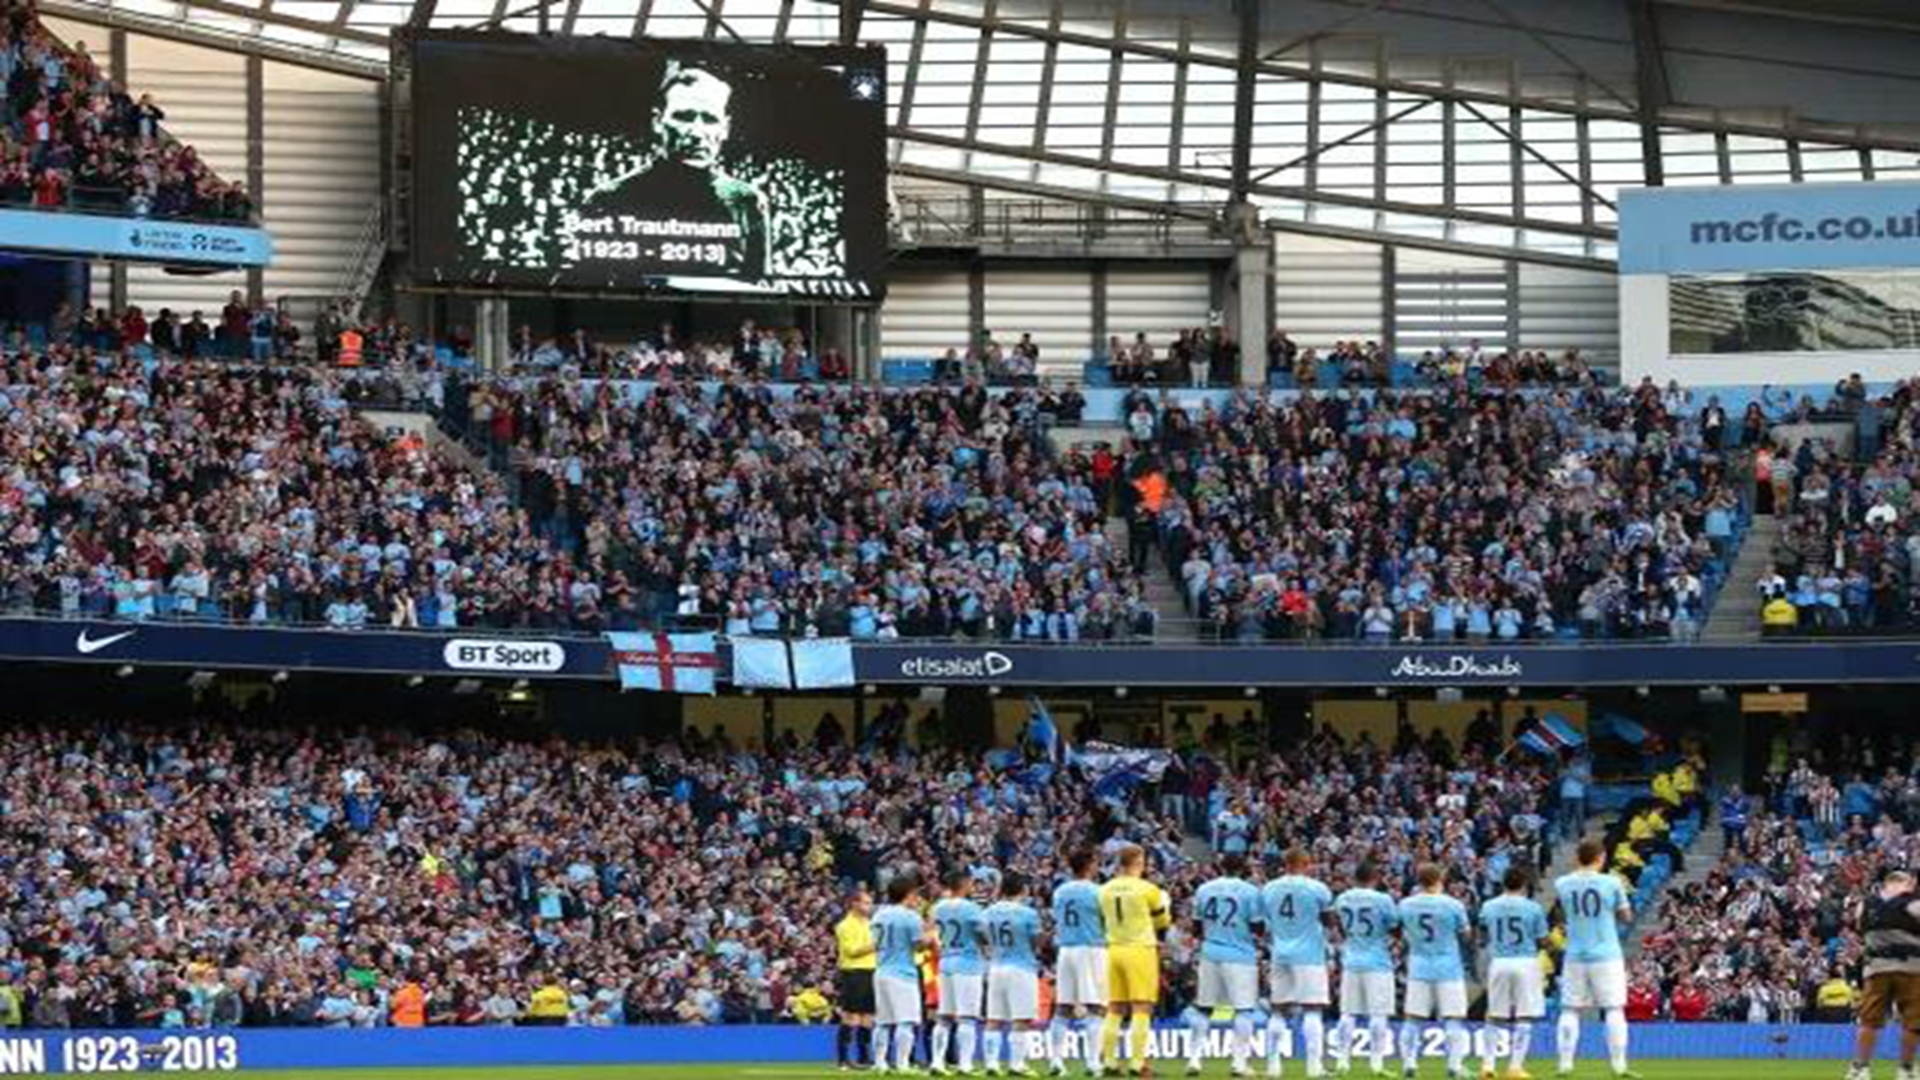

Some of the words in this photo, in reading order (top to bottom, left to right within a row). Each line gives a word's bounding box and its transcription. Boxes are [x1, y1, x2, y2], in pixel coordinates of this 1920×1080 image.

[563, 212, 615, 233] Bert
[618, 216, 741, 237] Trautmann
[1690, 209, 1920, 244] mcfc.co.u
[660, 243, 727, 266] 2013)
[458, 645, 491, 663] BT
[494, 644, 551, 667] Sport
[901, 657, 985, 677] etisalat
[1065, 899, 1079, 928] 6
[1115, 895, 1123, 923] 1
[1204, 896, 1238, 927] 42
[1279, 893, 1295, 921] 4
[1572, 888, 1600, 918] 10
[934, 919, 965, 949] 22
[989, 919, 1014, 948] 16
[1340, 905, 1375, 938] 25
[1419, 913, 1436, 943] 5
[1496, 916, 1523, 945] 15
